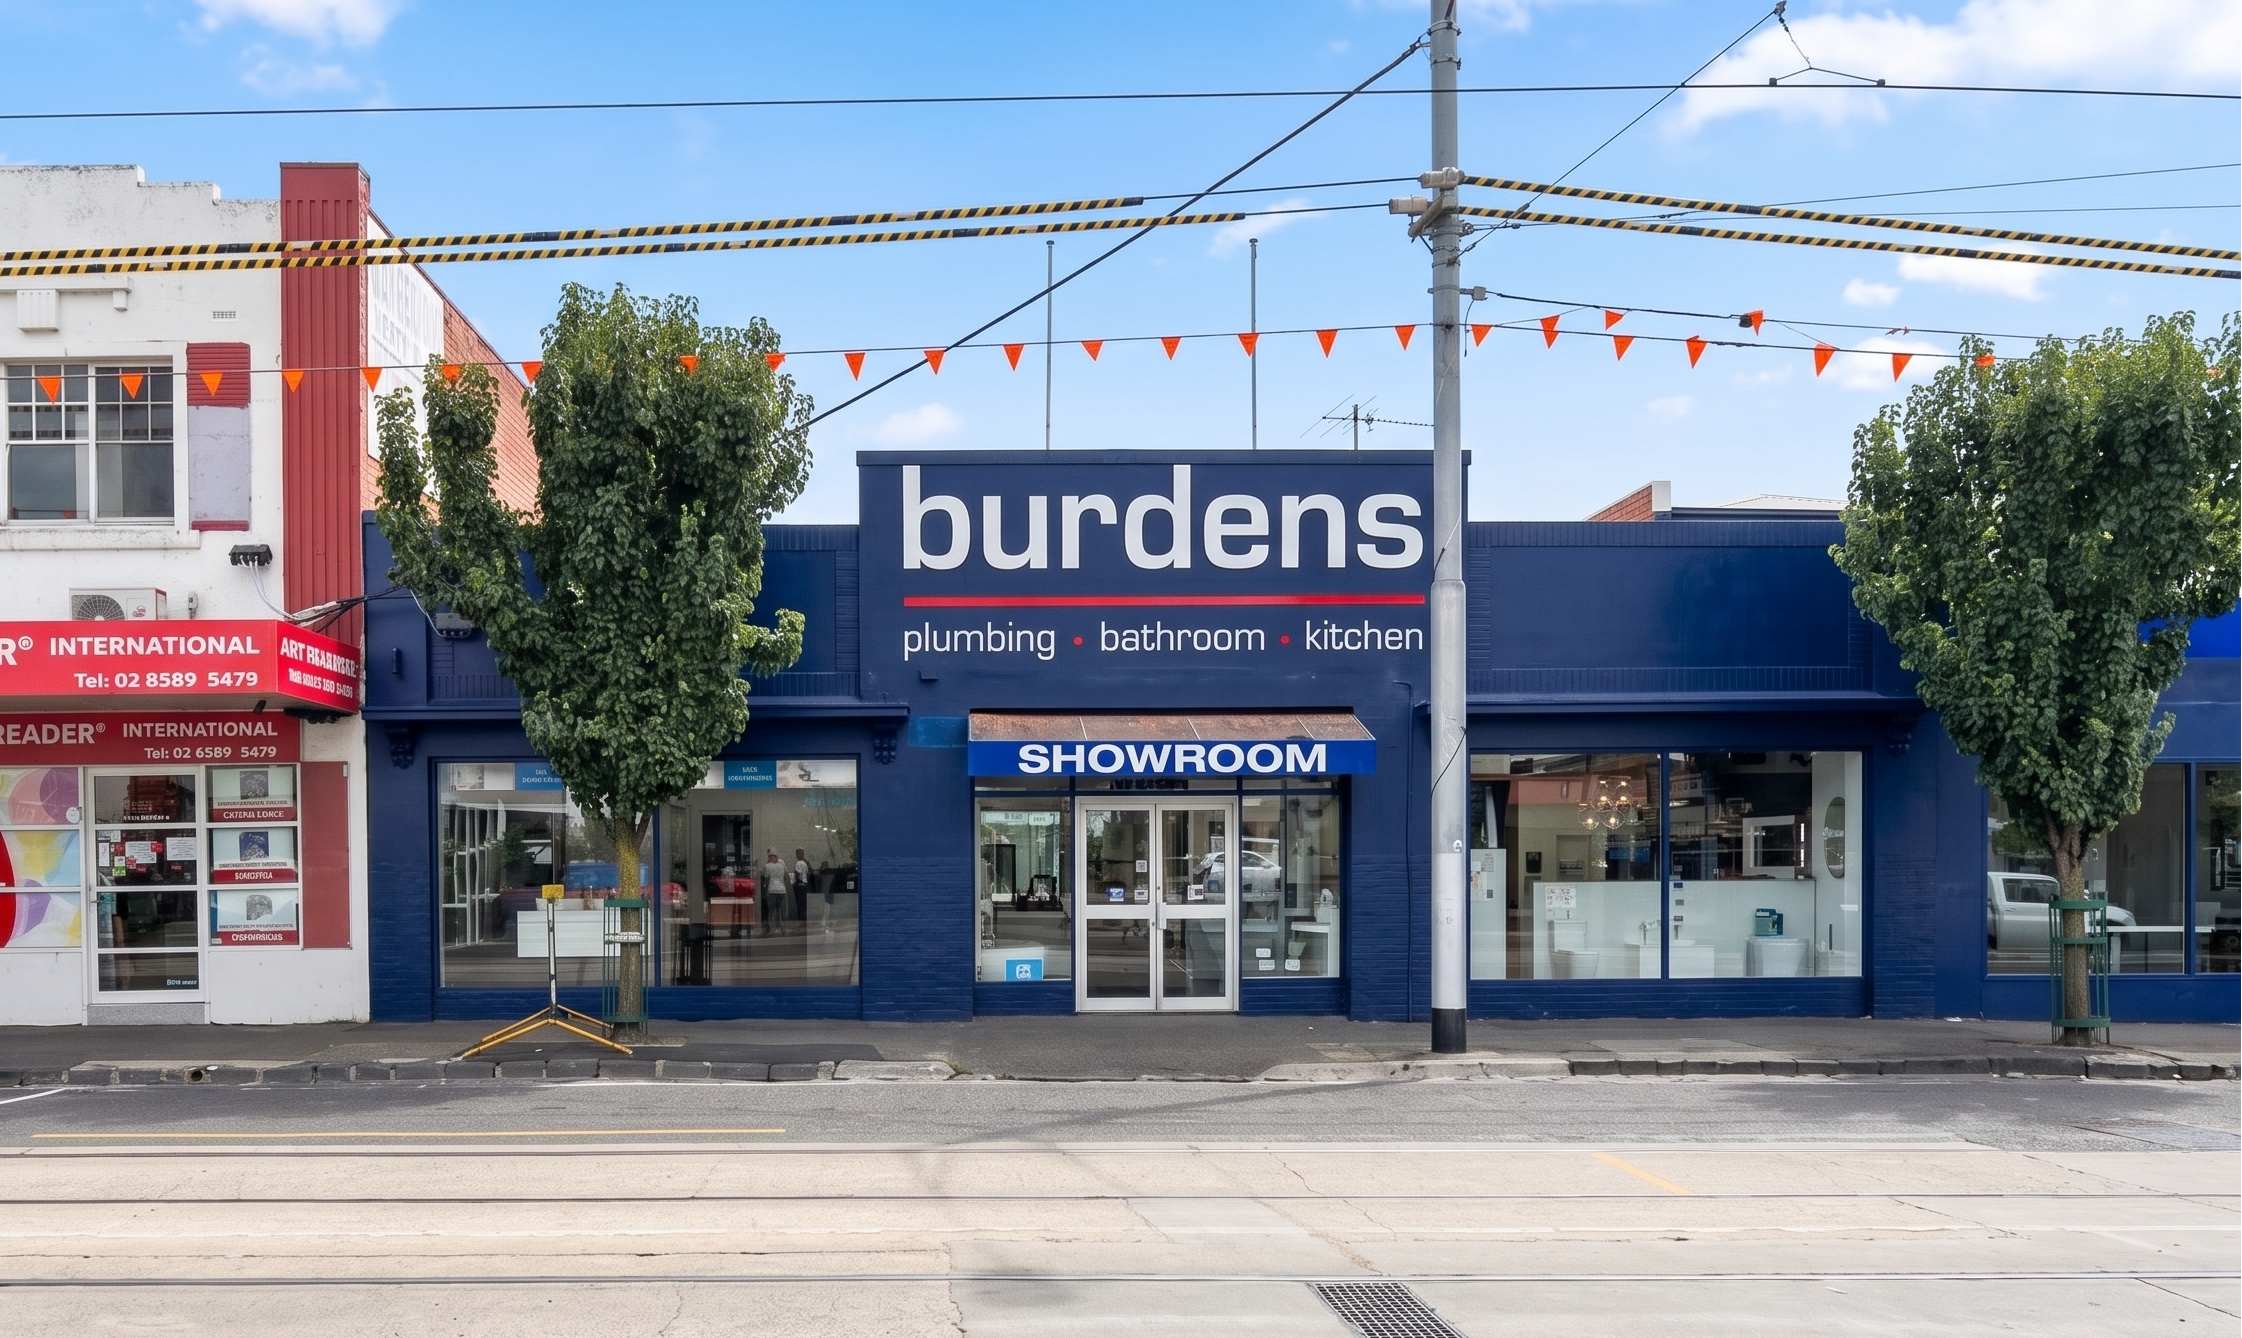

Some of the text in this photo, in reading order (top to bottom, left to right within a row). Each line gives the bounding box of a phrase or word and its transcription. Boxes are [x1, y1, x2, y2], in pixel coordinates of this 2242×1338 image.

[903, 465, 1424, 570] burdens
[50, 636, 261, 656] INTERNATIONAL
[904, 620, 1423, 661] plumbing bathroom kitchen
[74, 671, 258, 688] Tel: 02 8589 5479
[123, 721, 278, 738] INTERNATIONAL
[144, 746, 277, 759] Tel: 02 6589 5479
[1018, 743, 1326, 774] SHOWROOM
